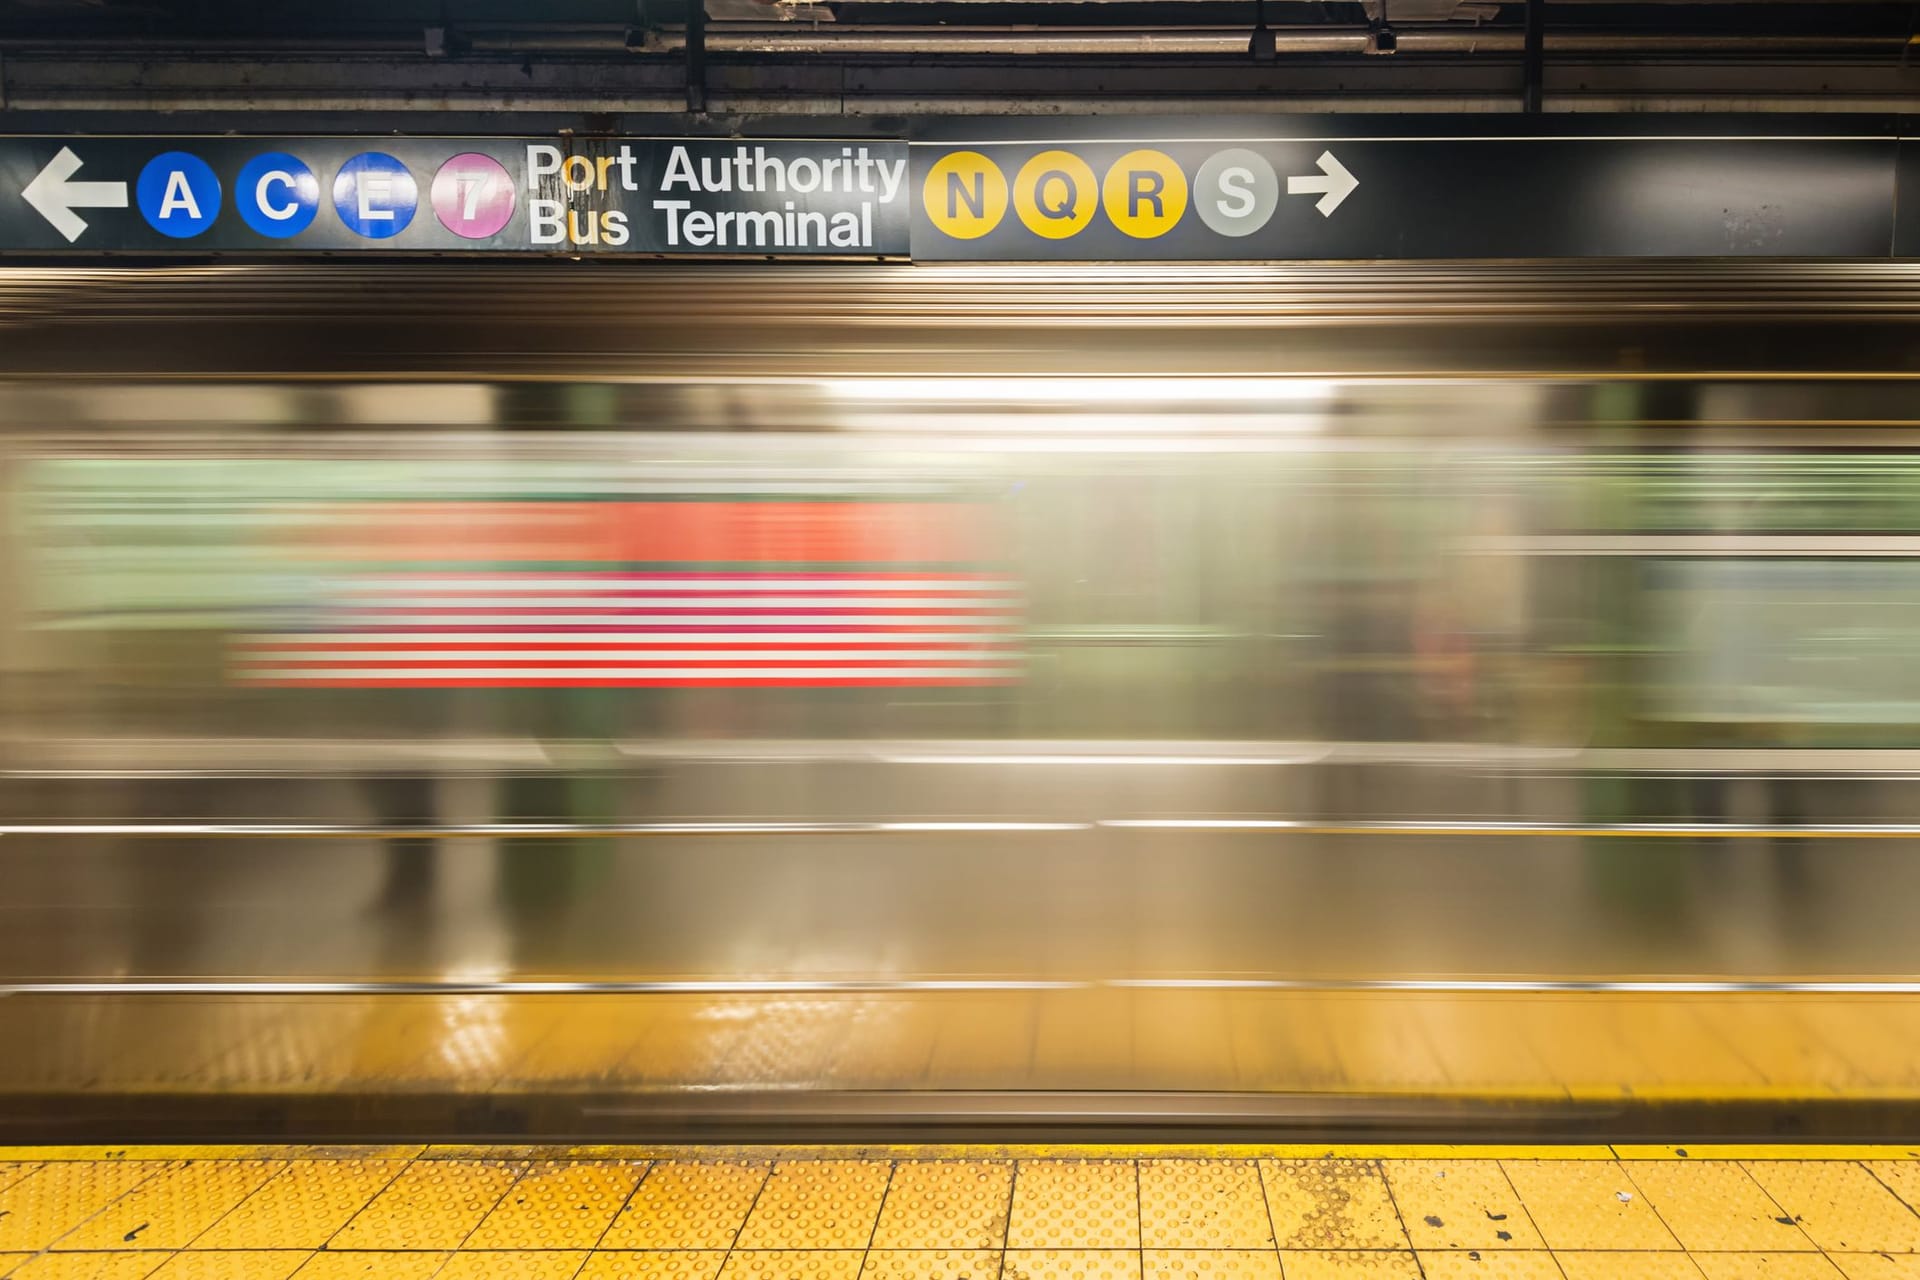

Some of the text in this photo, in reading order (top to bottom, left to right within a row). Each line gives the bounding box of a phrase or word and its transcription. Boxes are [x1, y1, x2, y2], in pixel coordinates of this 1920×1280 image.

[158, 170, 489, 221] A C E 7
[526, 144, 907, 203] Port Authority
[946, 166, 1256, 221] N Q R S
[529, 199, 873, 247] Bus Terminal
